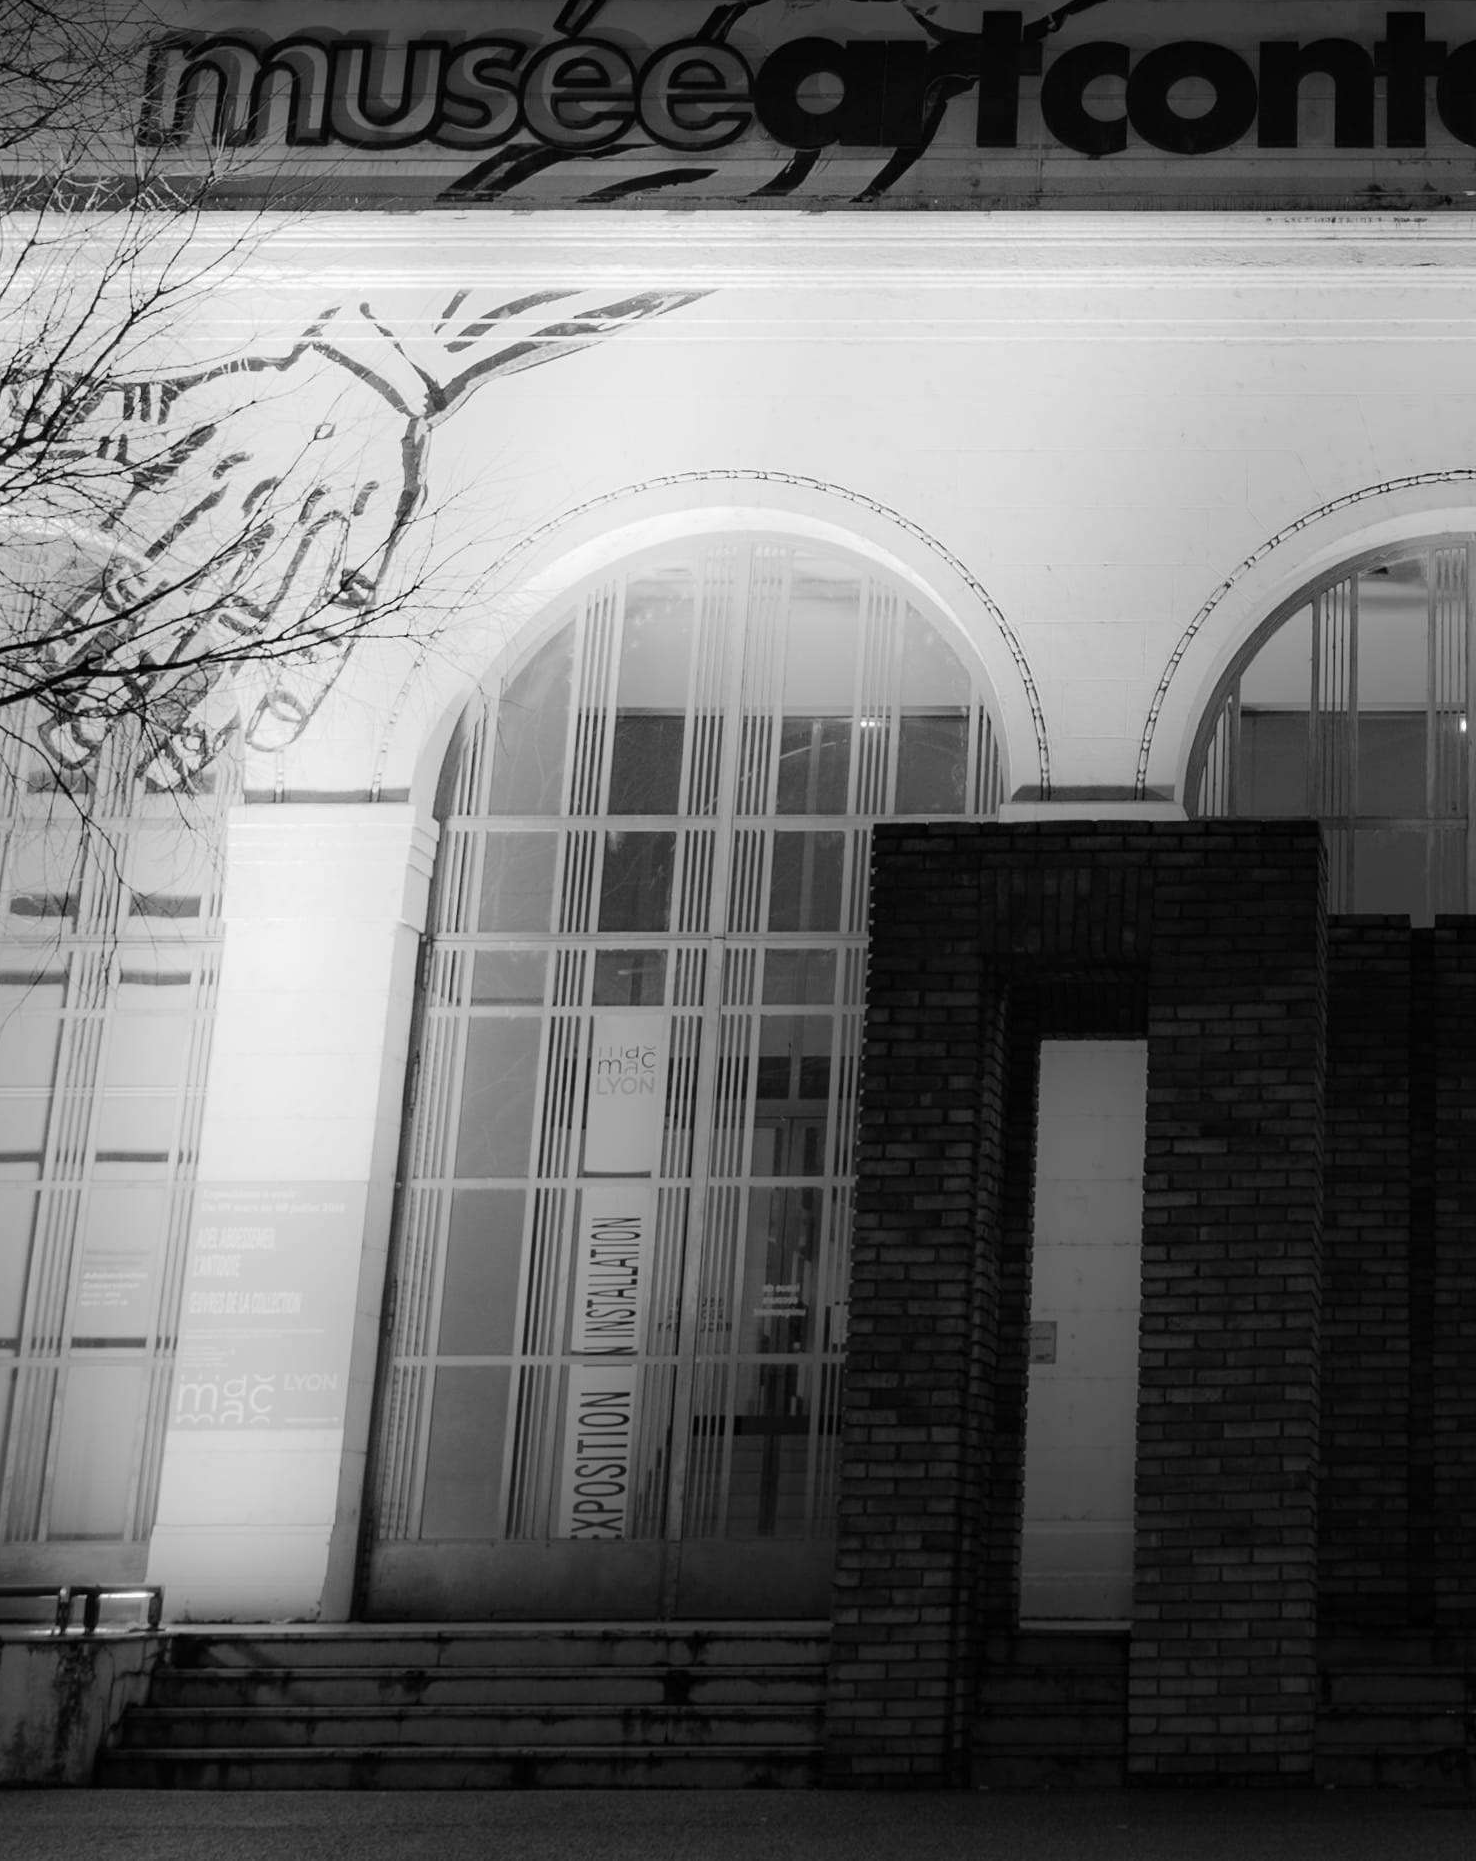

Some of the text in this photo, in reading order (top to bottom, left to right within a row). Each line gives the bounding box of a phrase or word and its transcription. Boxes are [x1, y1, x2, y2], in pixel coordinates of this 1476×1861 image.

[595, 1077, 656, 1095] LYON
[584, 1216, 642, 1338] INSTALLATION
[283, 1373, 338, 1392] LYON
[571, 1391, 631, 1539] XPOSITION
